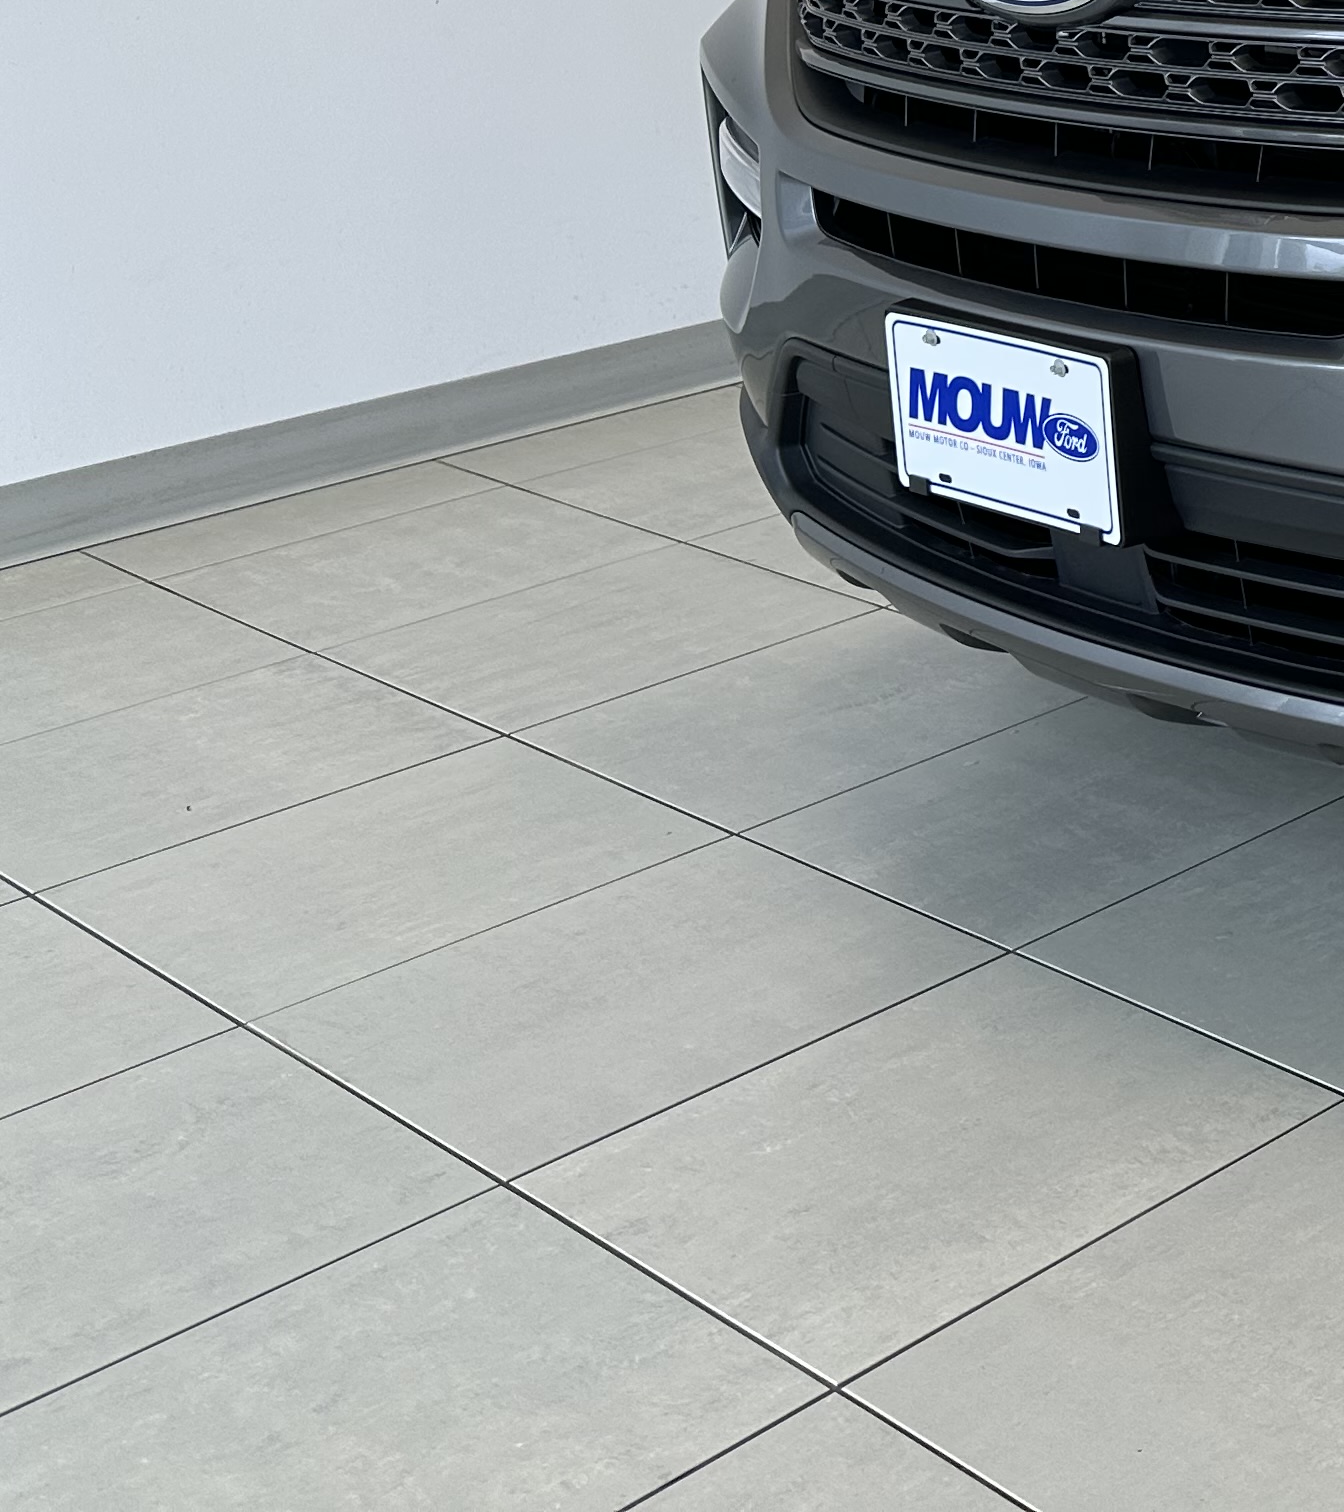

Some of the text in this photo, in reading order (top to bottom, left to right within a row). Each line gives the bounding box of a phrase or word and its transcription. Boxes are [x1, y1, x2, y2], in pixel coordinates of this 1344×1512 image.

[909, 367, 1052, 450] MOUW
[908, 429, 931, 442] MOUW
[933, 434, 958, 449] MOTOR
[959, 440, 969, 451] CO
[976, 444, 997, 458] SIOUX
[1028, 458, 1047, 471] IOWA
[1054, 419, 1088, 454] Ford
